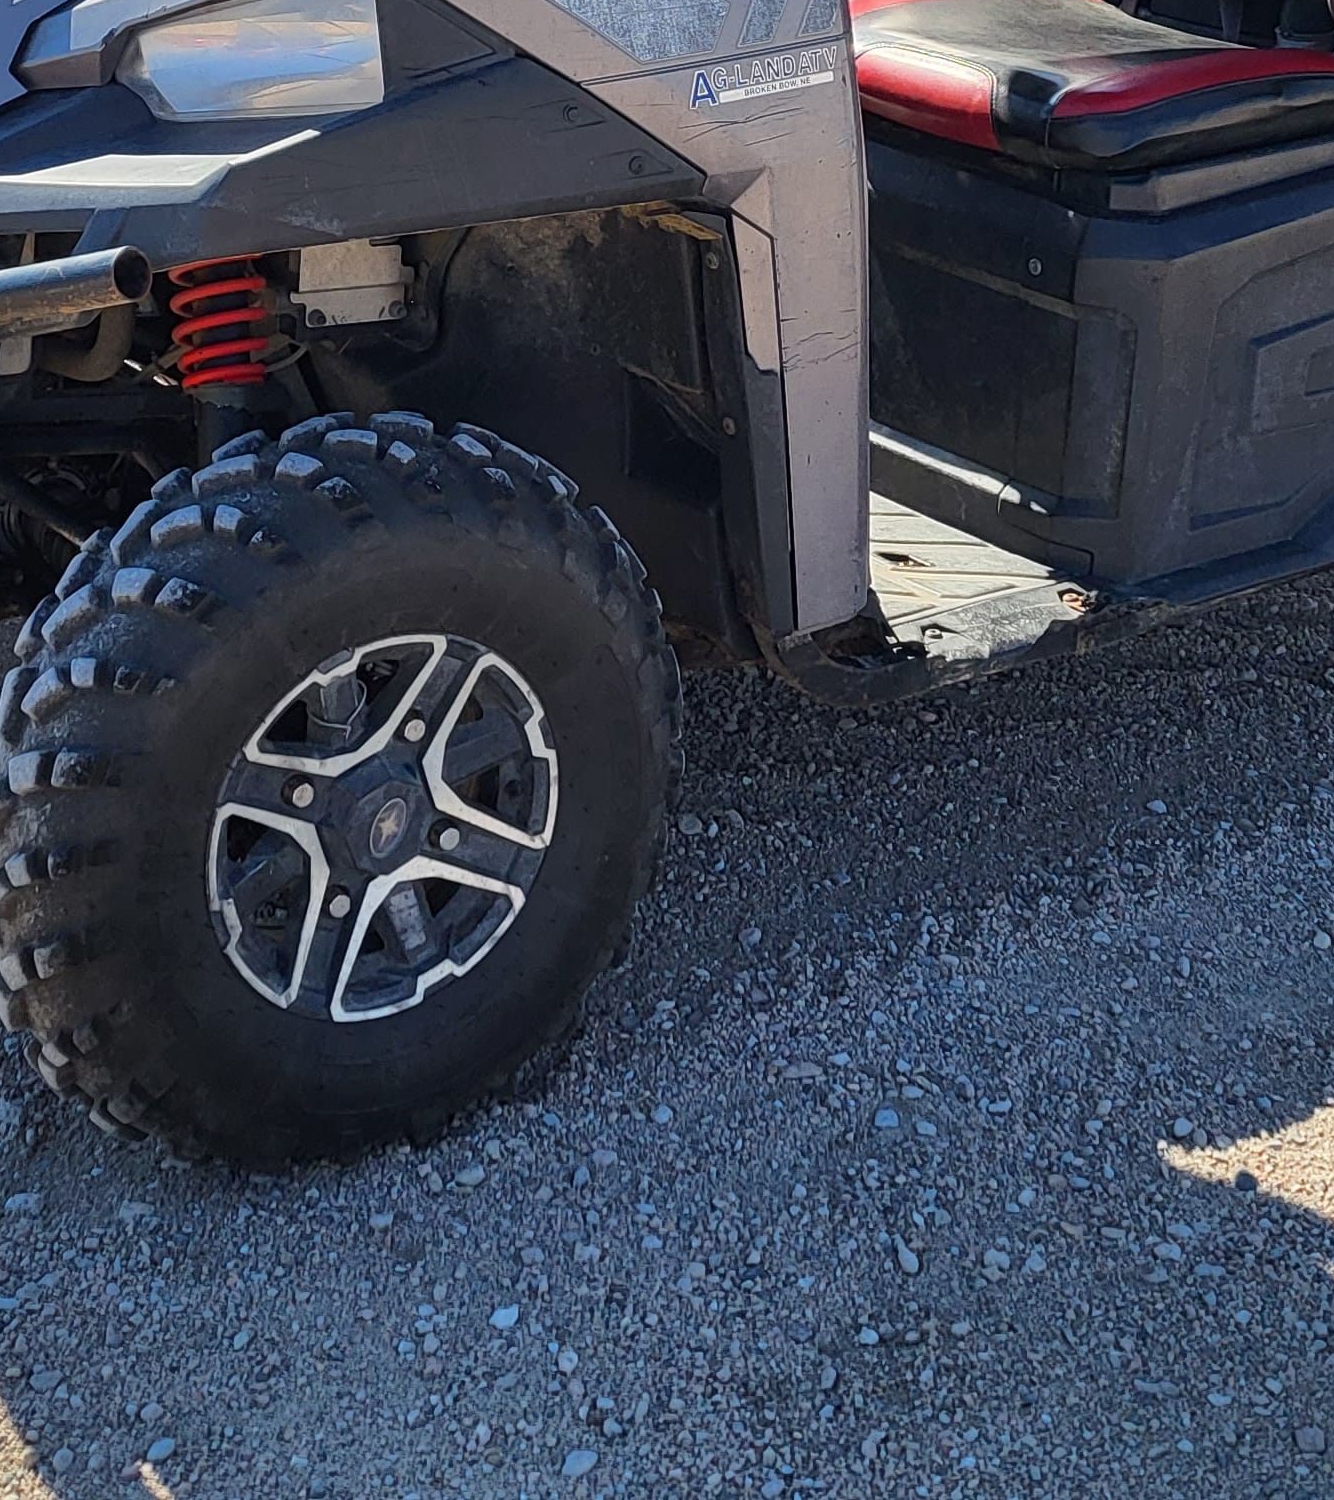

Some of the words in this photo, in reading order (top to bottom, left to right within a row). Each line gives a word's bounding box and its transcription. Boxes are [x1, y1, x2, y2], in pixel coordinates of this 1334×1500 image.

[690, 54, 796, 110] AG-LAND
[798, 46, 837, 75] ATV
[743, 83, 777, 97] BROKEN
[778, 78, 799, 92] BOW,
[800, 76, 811, 85] NE
